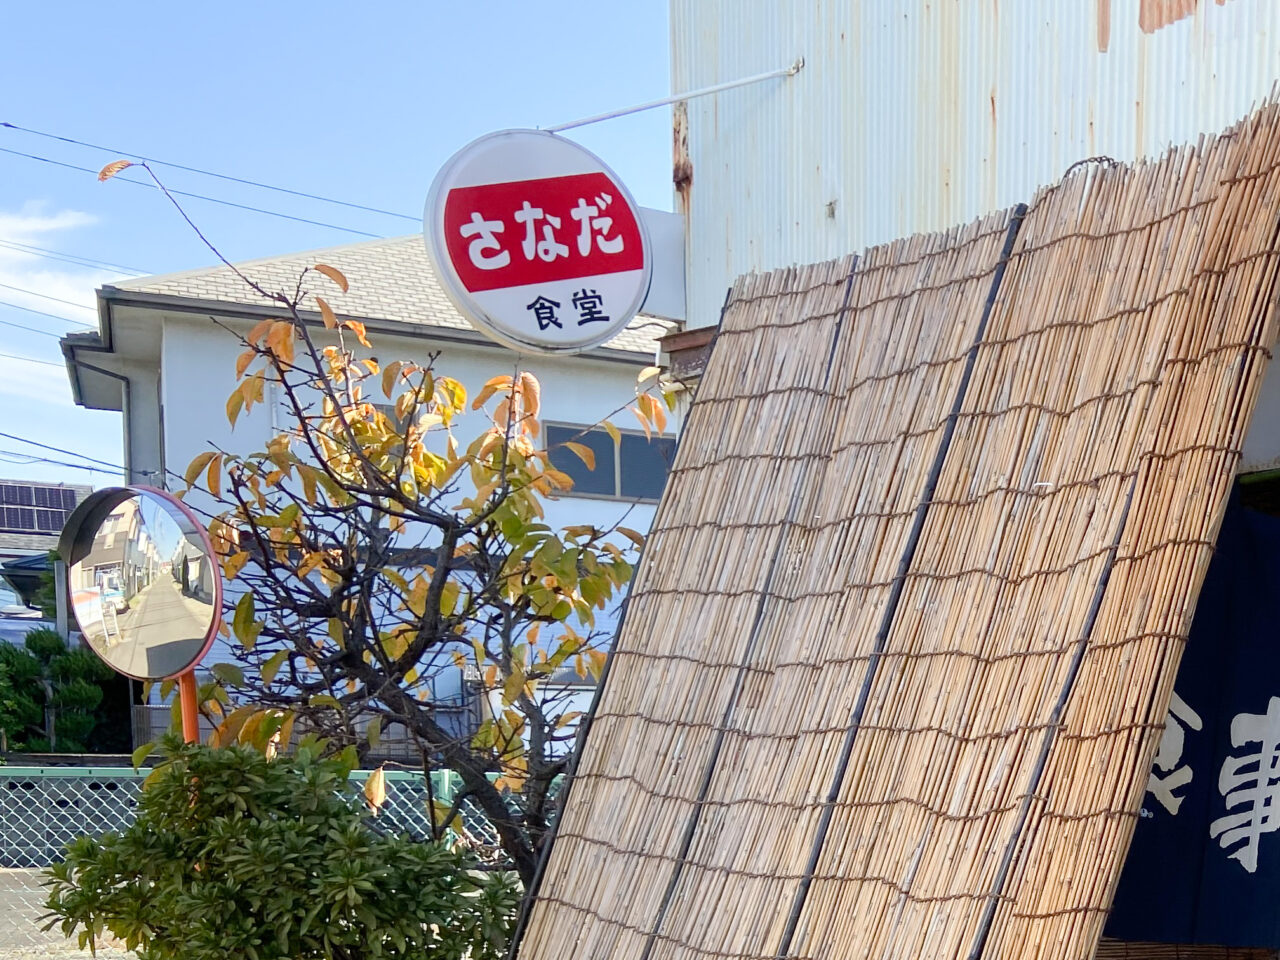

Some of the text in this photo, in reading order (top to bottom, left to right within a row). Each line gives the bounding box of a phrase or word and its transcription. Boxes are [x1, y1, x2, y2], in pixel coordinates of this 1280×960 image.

[460, 192, 624, 270] さなだ
[527, 288, 610, 330] 食堂
